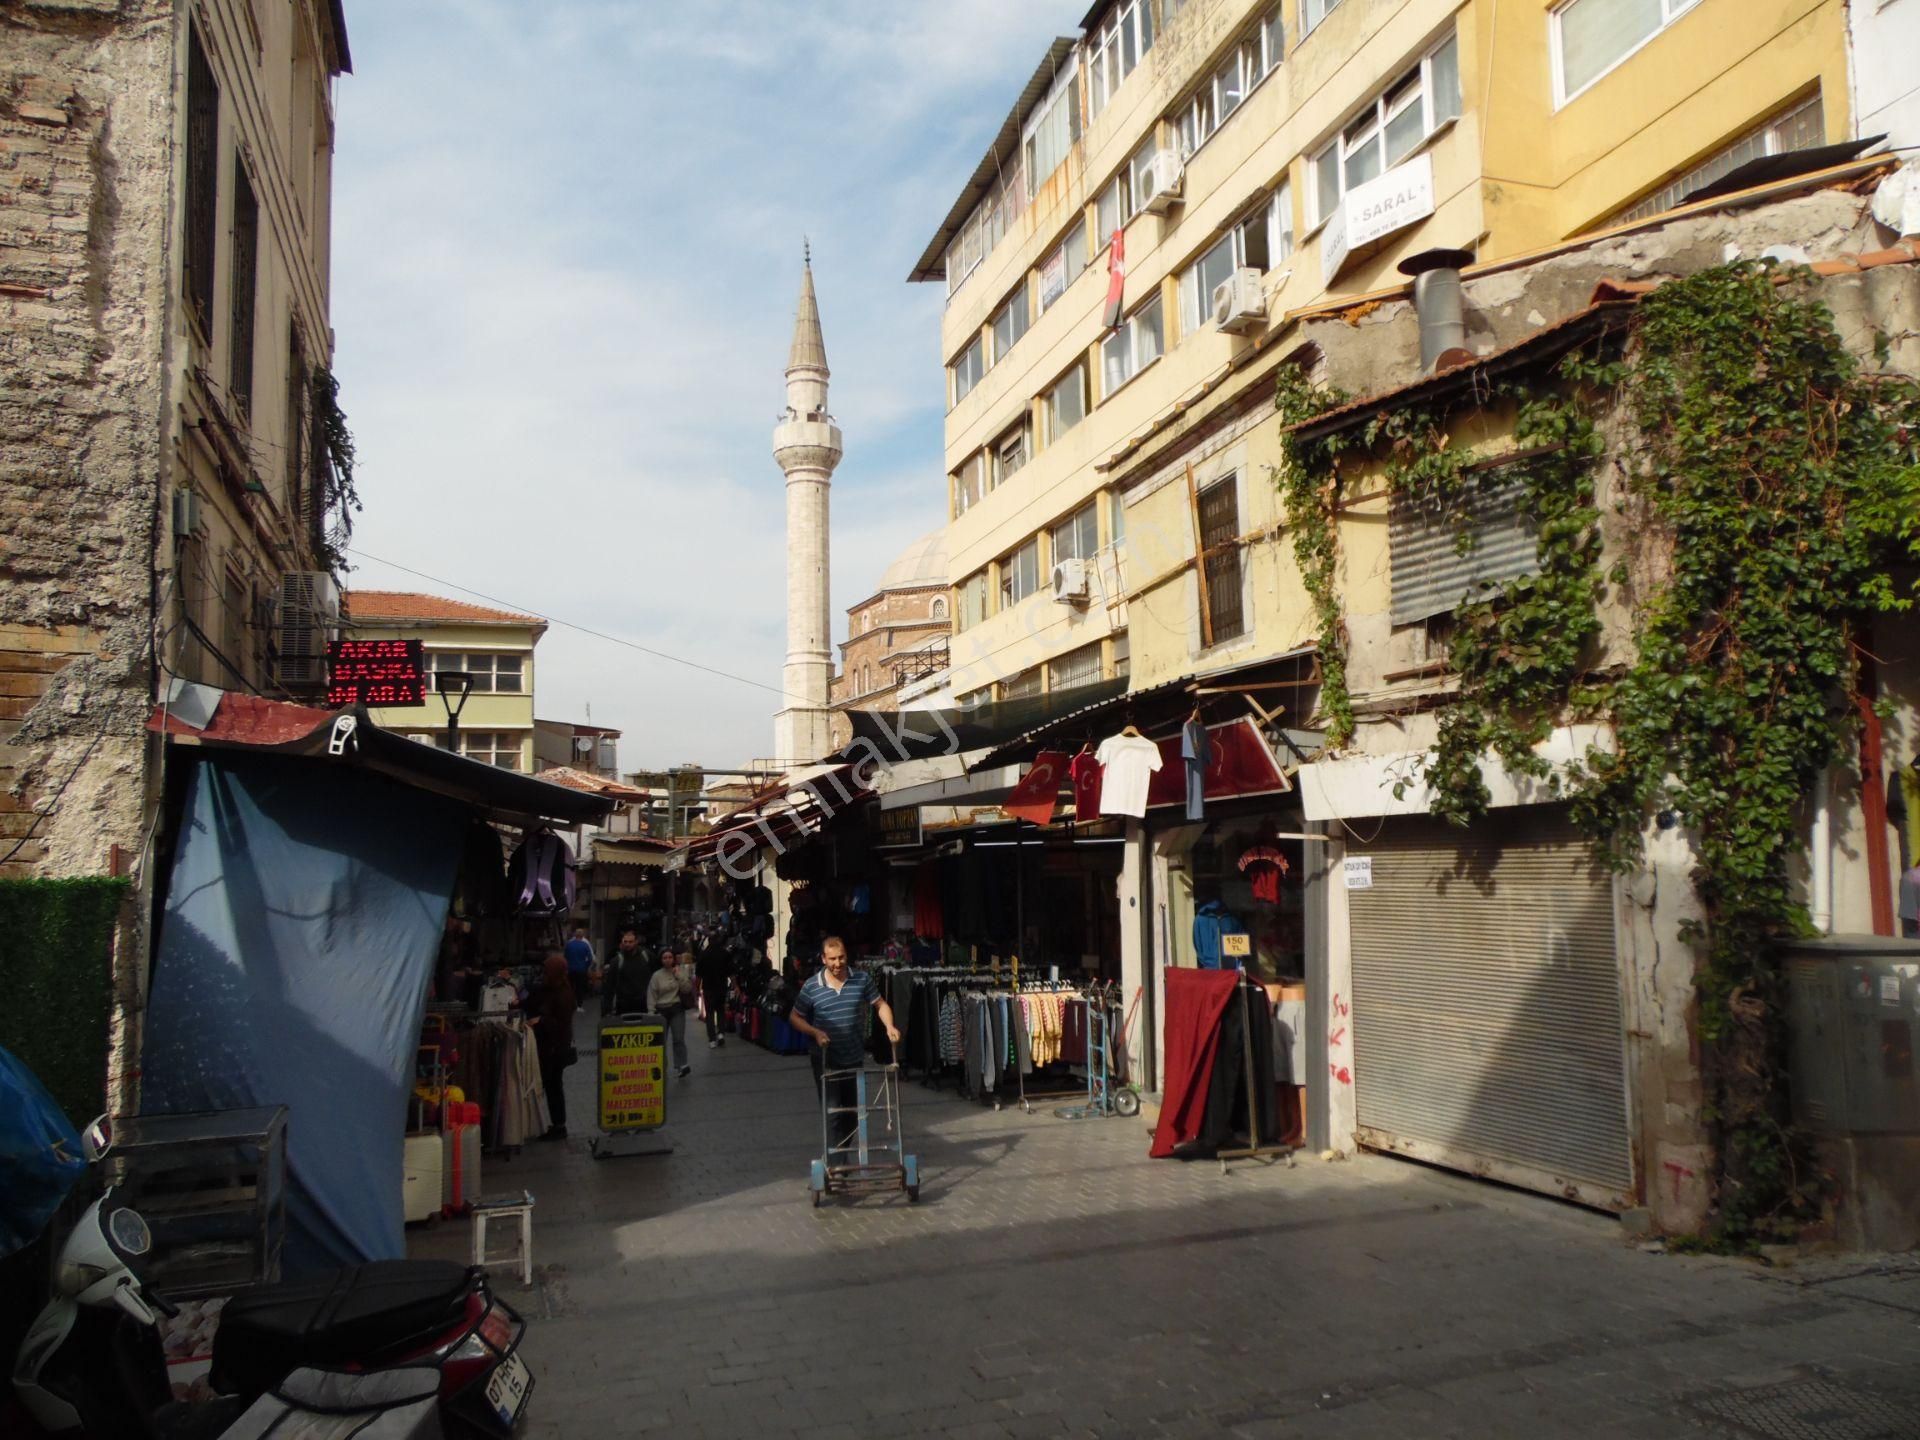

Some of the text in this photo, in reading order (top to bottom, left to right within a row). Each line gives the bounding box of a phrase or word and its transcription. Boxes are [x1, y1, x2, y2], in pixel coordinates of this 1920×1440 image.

[1362, 188, 1417, 222] SARAL
[1226, 936, 1243, 945] 150
[612, 1033, 654, 1048] YAKUP
[488, 1378, 504, 1404] 07
[508, 1376, 523, 1400] 15
